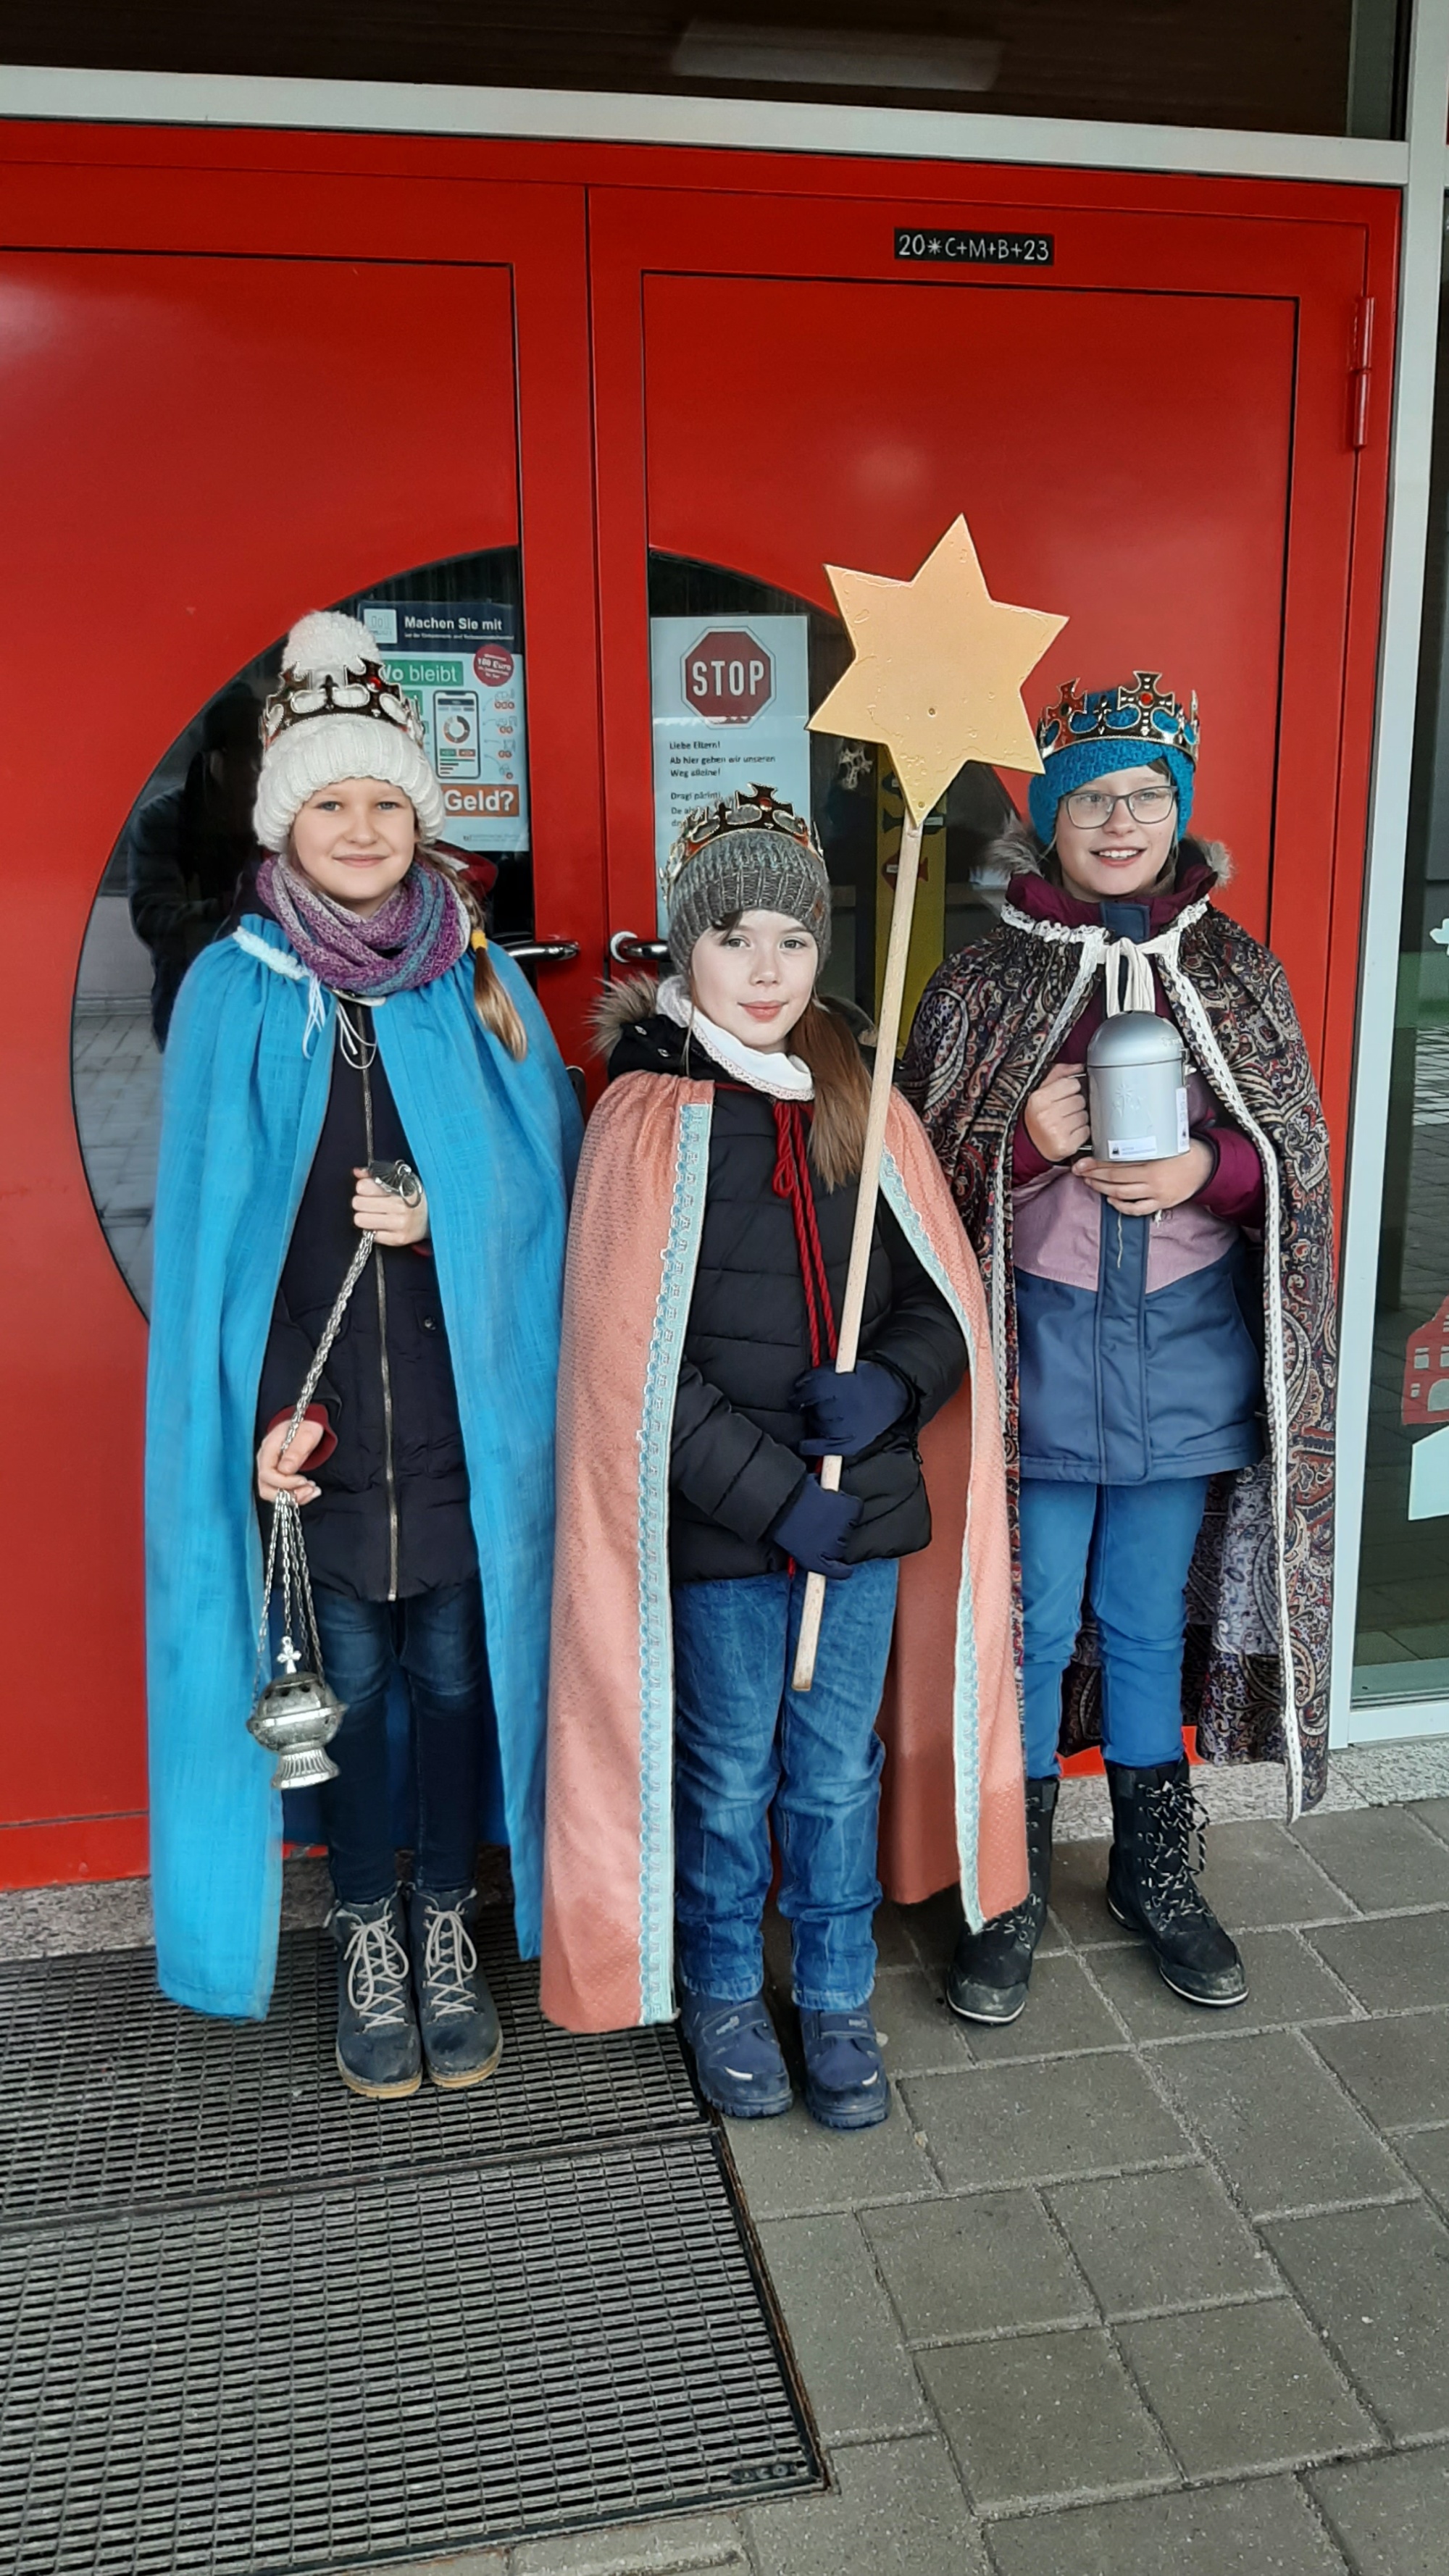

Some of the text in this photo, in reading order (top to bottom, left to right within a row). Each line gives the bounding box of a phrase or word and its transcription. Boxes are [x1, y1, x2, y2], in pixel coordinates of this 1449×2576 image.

[404, 616, 503, 630] Machen Sie mit
[409, 664, 457, 682] bleibt
[693, 660, 764, 696] STOP
[669, 740, 721, 750] Liebe Eltern!
[670, 769, 688, 778] Weg
[444, 789, 514, 811] Geld?
